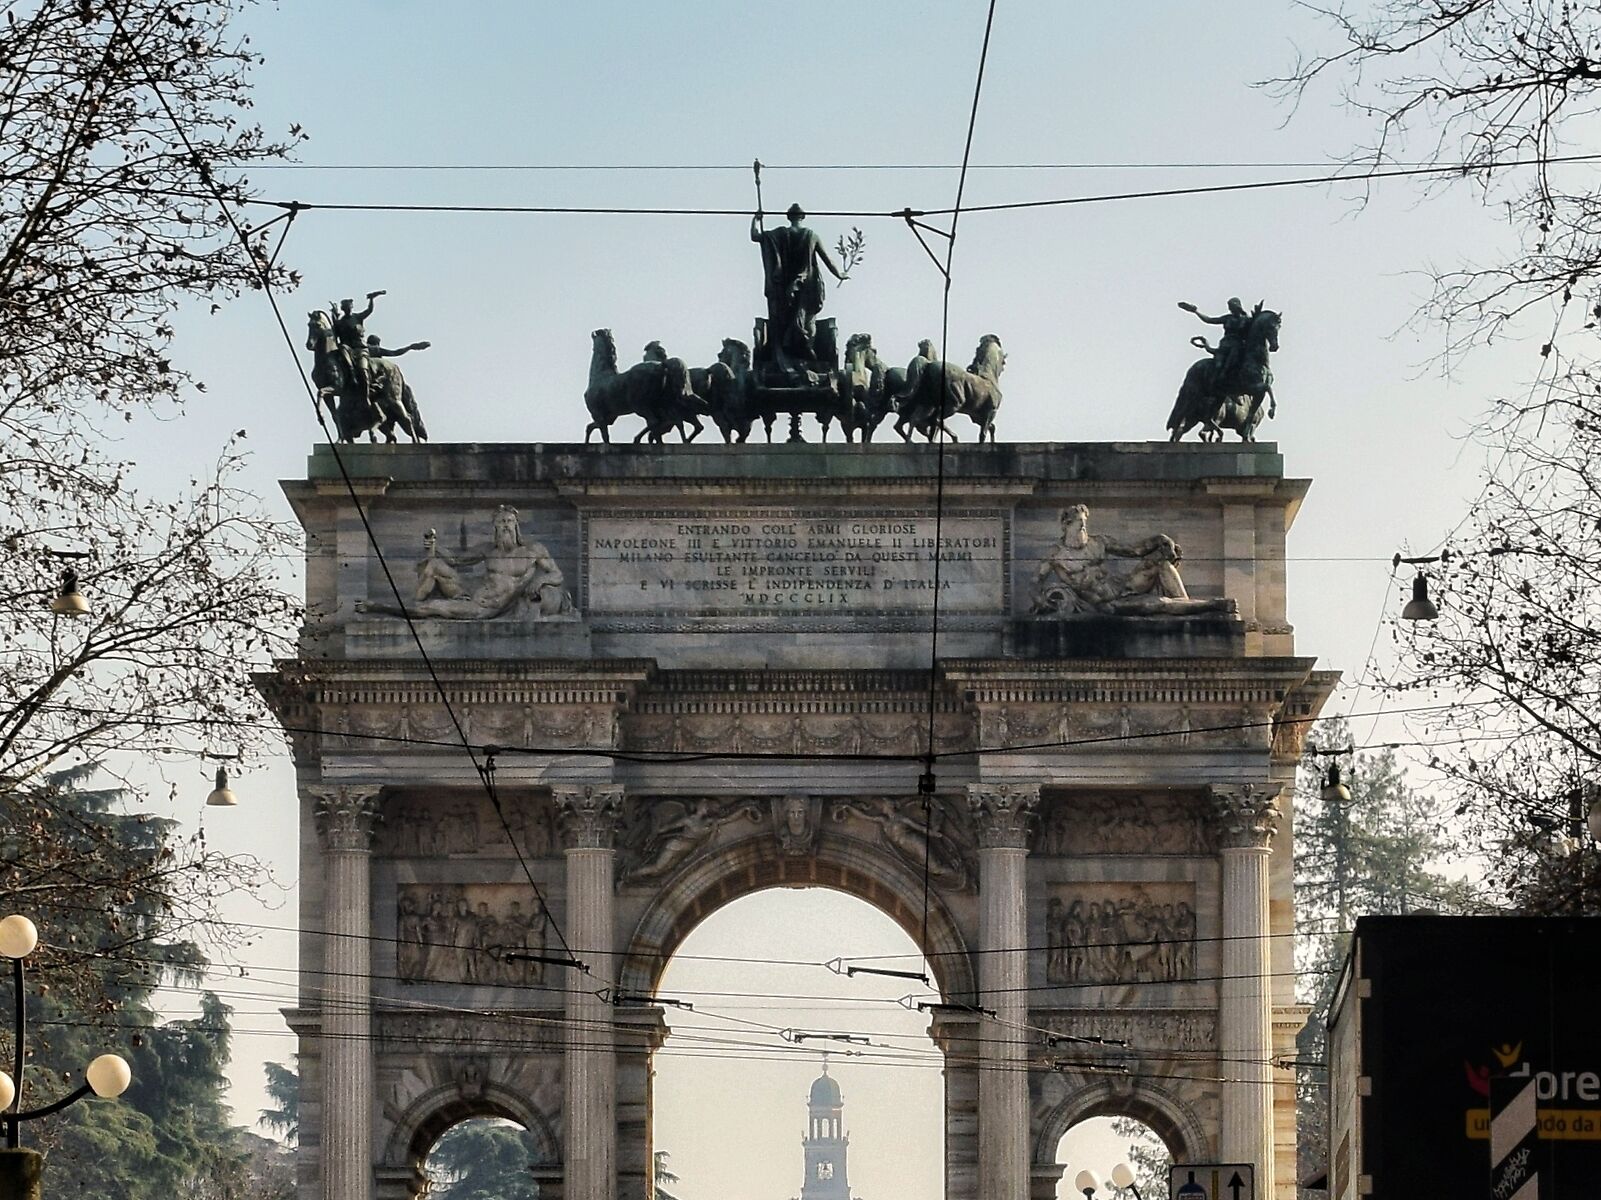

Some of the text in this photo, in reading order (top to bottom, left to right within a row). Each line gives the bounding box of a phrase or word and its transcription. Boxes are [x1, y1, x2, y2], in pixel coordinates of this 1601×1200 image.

[677, 524, 751, 535] ENTRANDO
[807, 524, 841, 535] ARMI
[851, 524, 917, 535] GLORIOSE
[595, 537, 997, 549] NAPOLEONE III E VITTORIO EMANUELE II LIBERATORI
[619, 552, 674, 563] MILANO
[684, 552, 758, 563] ESULTANTE
[844, 551, 862, 562] DA
[872, 551, 920, 562] QUESTI
[928, 551, 973, 561] MARMI
[717, 566, 876, 577] LE IMPRONTE SERVILI
[640, 580, 648, 590] E
[660, 580, 675, 590] VI
[686, 580, 737, 590] SCRISSE
[766, 580, 872, 590] INDIPENDENZA
[904, 579, 951, 590] ITALIA
[1572, 1116, 1594, 1132] da
